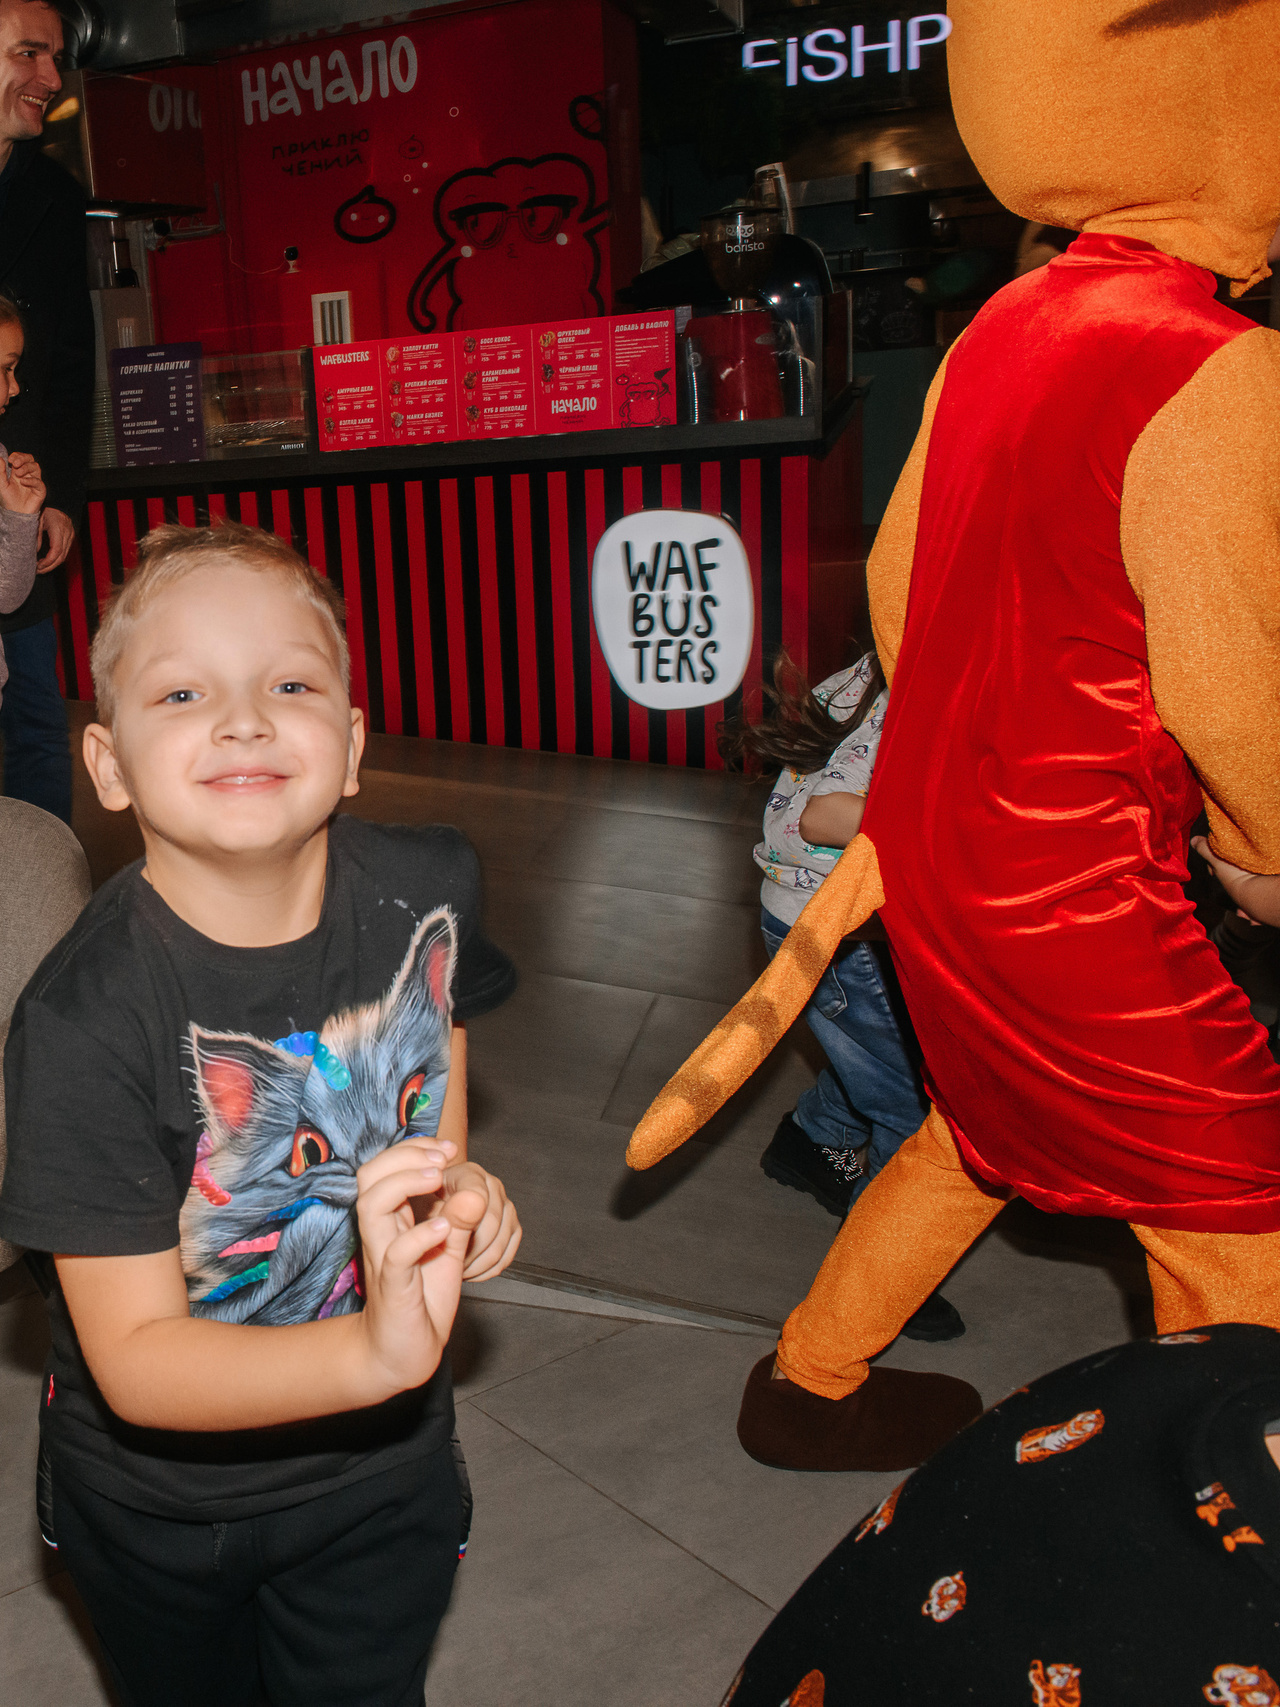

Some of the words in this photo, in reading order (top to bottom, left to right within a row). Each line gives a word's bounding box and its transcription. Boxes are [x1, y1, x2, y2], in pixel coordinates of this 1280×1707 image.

[725, 240, 765, 254] barista
[614, 324, 639, 333] ДОБАВЬ
[646, 321, 669, 329] ВАФЛЮ
[120, 364, 152, 375] ГОРЯЧИЕ
[154, 360, 191, 372] НАПИТКИ
[622, 538, 723, 592] WAF
[629, 593, 718, 638] BUS
[629, 639, 719, 684] TERS
